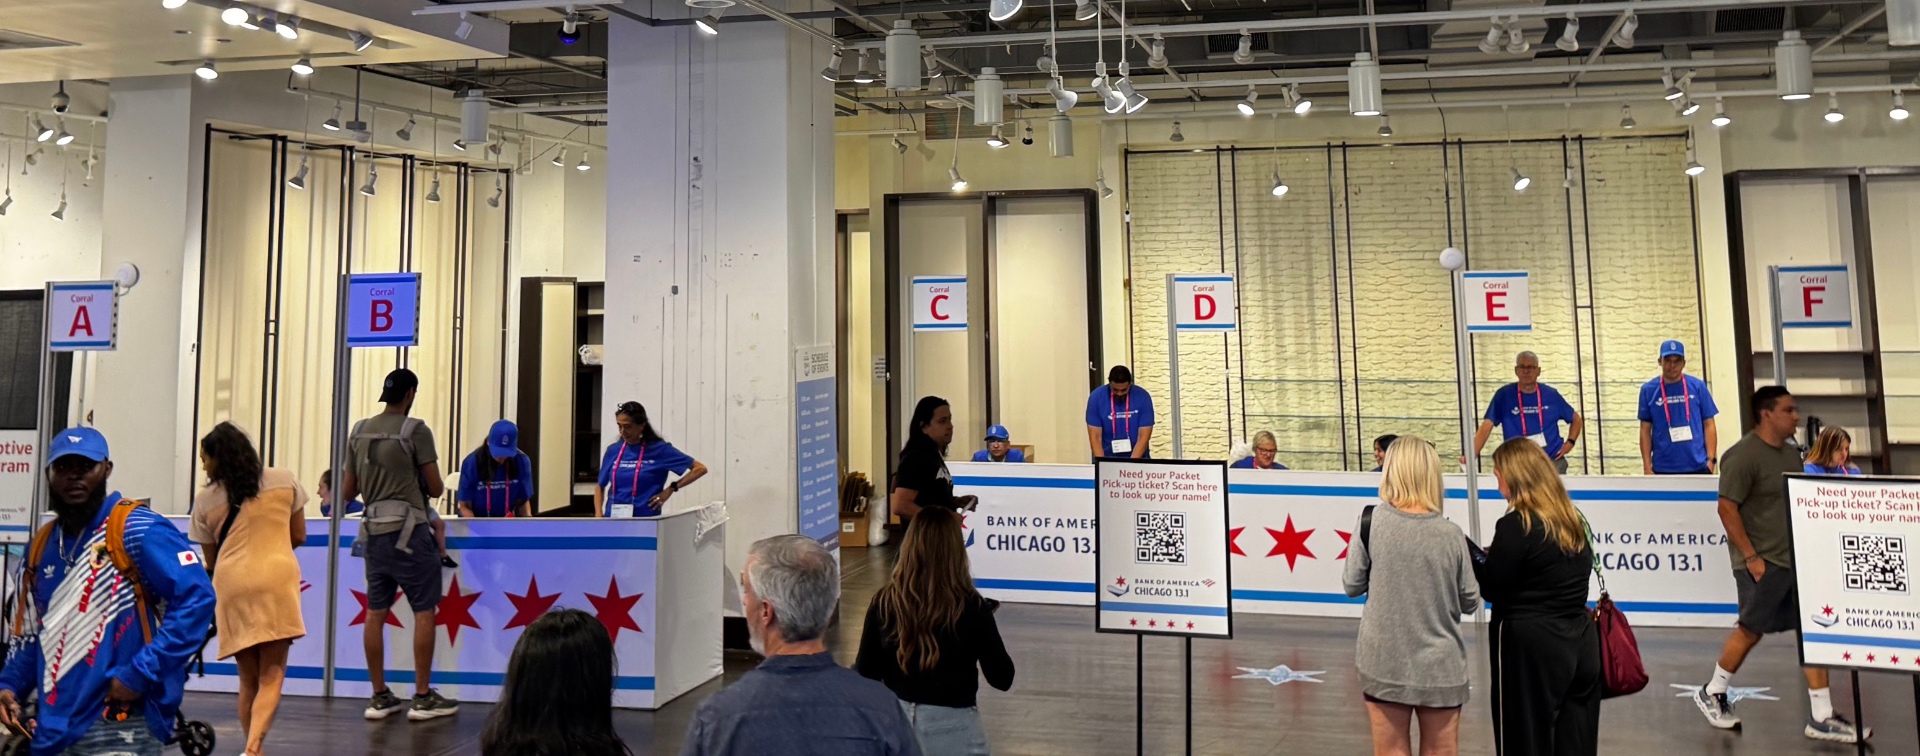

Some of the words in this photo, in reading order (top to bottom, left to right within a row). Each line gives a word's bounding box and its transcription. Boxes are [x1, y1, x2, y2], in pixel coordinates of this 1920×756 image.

[1800, 275, 1827, 284] Corral
[71, 294, 94, 302] Corral
[370, 288, 394, 296] Corral
[931, 295, 950, 320] C
[1194, 294, 1216, 320] D
[1486, 292, 1509, 321] E
[1803, 286, 1826, 317] F
[69, 305, 93, 337] A
[370, 299, 393, 332] B
[1120, 470, 1143, 478] Need
[1146, 472, 1166, 480] your
[1170, 472, 1200, 480] Packet
[1103, 480, 1136, 490] Pick-up
[1139, 481, 1169, 490] ticket?
[1173, 482, 1194, 490] Scan
[1197, 483, 1218, 491] here
[1123, 491, 1141, 499] look
[1145, 493, 1156, 501] up
[1160, 493, 1179, 502] your
[1817, 487, 1846, 496] Need
[1851, 490, 1876, 499] your
[1881, 489, 1920, 500] Packet
[1797, 498, 1838, 509] Pick-up
[1842, 499, 1881, 510] ticket?
[1885, 502, 1913, 511] Scan
[987, 516, 1027, 527] BANK
[1033, 517, 1051, 528] OF
[1807, 511, 1818, 519] to
[1823, 510, 1847, 520] look
[1851, 513, 1865, 522] up
[1869, 514, 1895, 523] your
[986, 534, 1065, 552] CHICAGO
[1620, 533, 1642, 544] OF
[1648, 533, 1728, 545] AMERICA
[1668, 554, 1702, 571] 13.1
[1135, 587, 1172, 596] CHICAGO
[1175, 589, 1189, 597] 13.1
[1846, 617, 1893, 629] CHICAGO
[1898, 620, 1914, 631] 13.1
